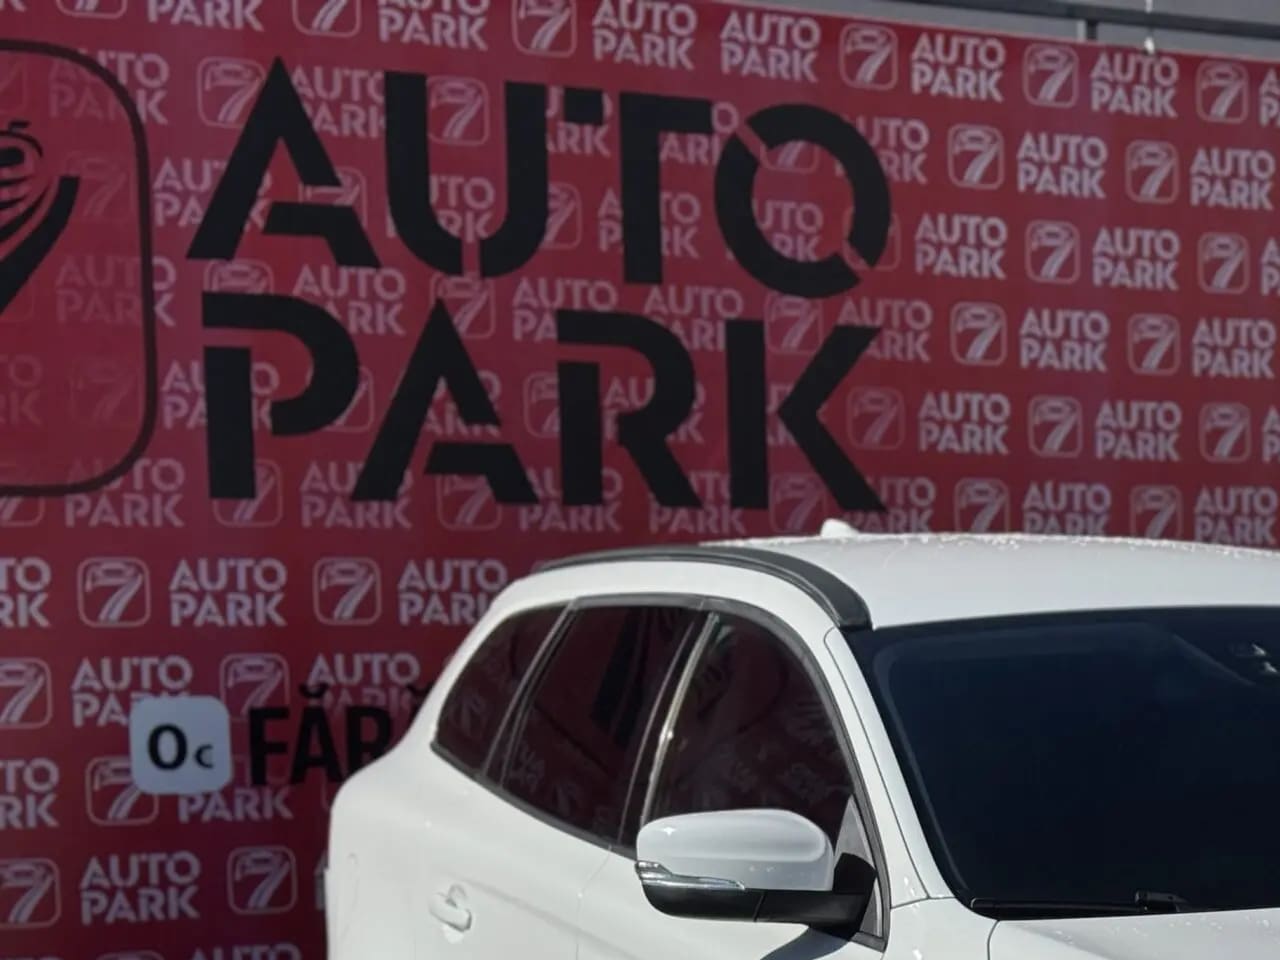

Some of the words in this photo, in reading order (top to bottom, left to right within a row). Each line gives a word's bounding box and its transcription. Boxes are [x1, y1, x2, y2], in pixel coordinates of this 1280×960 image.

[378, 9, 488, 51] PARK
[592, 0, 697, 36] AUTO
[720, 10, 821, 50] AUTO
[592, 29, 694, 70] PARK
[720, 42, 818, 82] PARK
[911, 33, 1006, 69] AUTO
[911, 62, 1004, 103] PARK
[1090, 52, 1178, 88] AUTO
[1090, 81, 1177, 118] PARK
[856, 116, 930, 151] UTO
[1017, 132, 1107, 167] AUTO
[186, 56, 891, 298] AUTO
[1017, 160, 1105, 198] PARK
[1190, 148, 1276, 180] AUTO
[1190, 177, 1273, 211] PARK
[915, 213, 1007, 247] AUTO
[1093, 228, 1180, 261] AUTO
[915, 245, 1006, 280] PARK
[1093, 257, 1178, 291] PARK
[292, 264, 406, 299] AUTO
[512, 277, 618, 311] AUTO
[643, 284, 744, 319] AUTO
[839, 297, 932, 331] AUTO
[1020, 308, 1109, 341] AUTO
[1192, 318, 1276, 349] AUTO
[1020, 336, 1106, 372] PARK
[1193, 345, 1274, 379] PARK
[202, 290, 888, 512] PARK
[919, 392, 1010, 422] AUTO
[1096, 400, 1181, 430] AUTO
[919, 421, 1008, 455] PARK
[1096, 430, 1180, 461] PARK
[65, 494, 185, 527] PARK
[302, 496, 411, 529] PARK
[1022, 482, 1112, 512] AUTO
[1195, 487, 1278, 515] AUTO
[1023, 510, 1110, 536] PARK
[1195, 514, 1276, 544] PARK
[169, 557, 287, 592] AUTO
[397, 559, 508, 590] AUTO
[170, 593, 287, 627] PARK
[71, 655, 193, 690] AUTO
[307, 654, 420, 687] AUTO
[80, 850, 200, 888] AUTO
[80, 886, 200, 925] PARK
